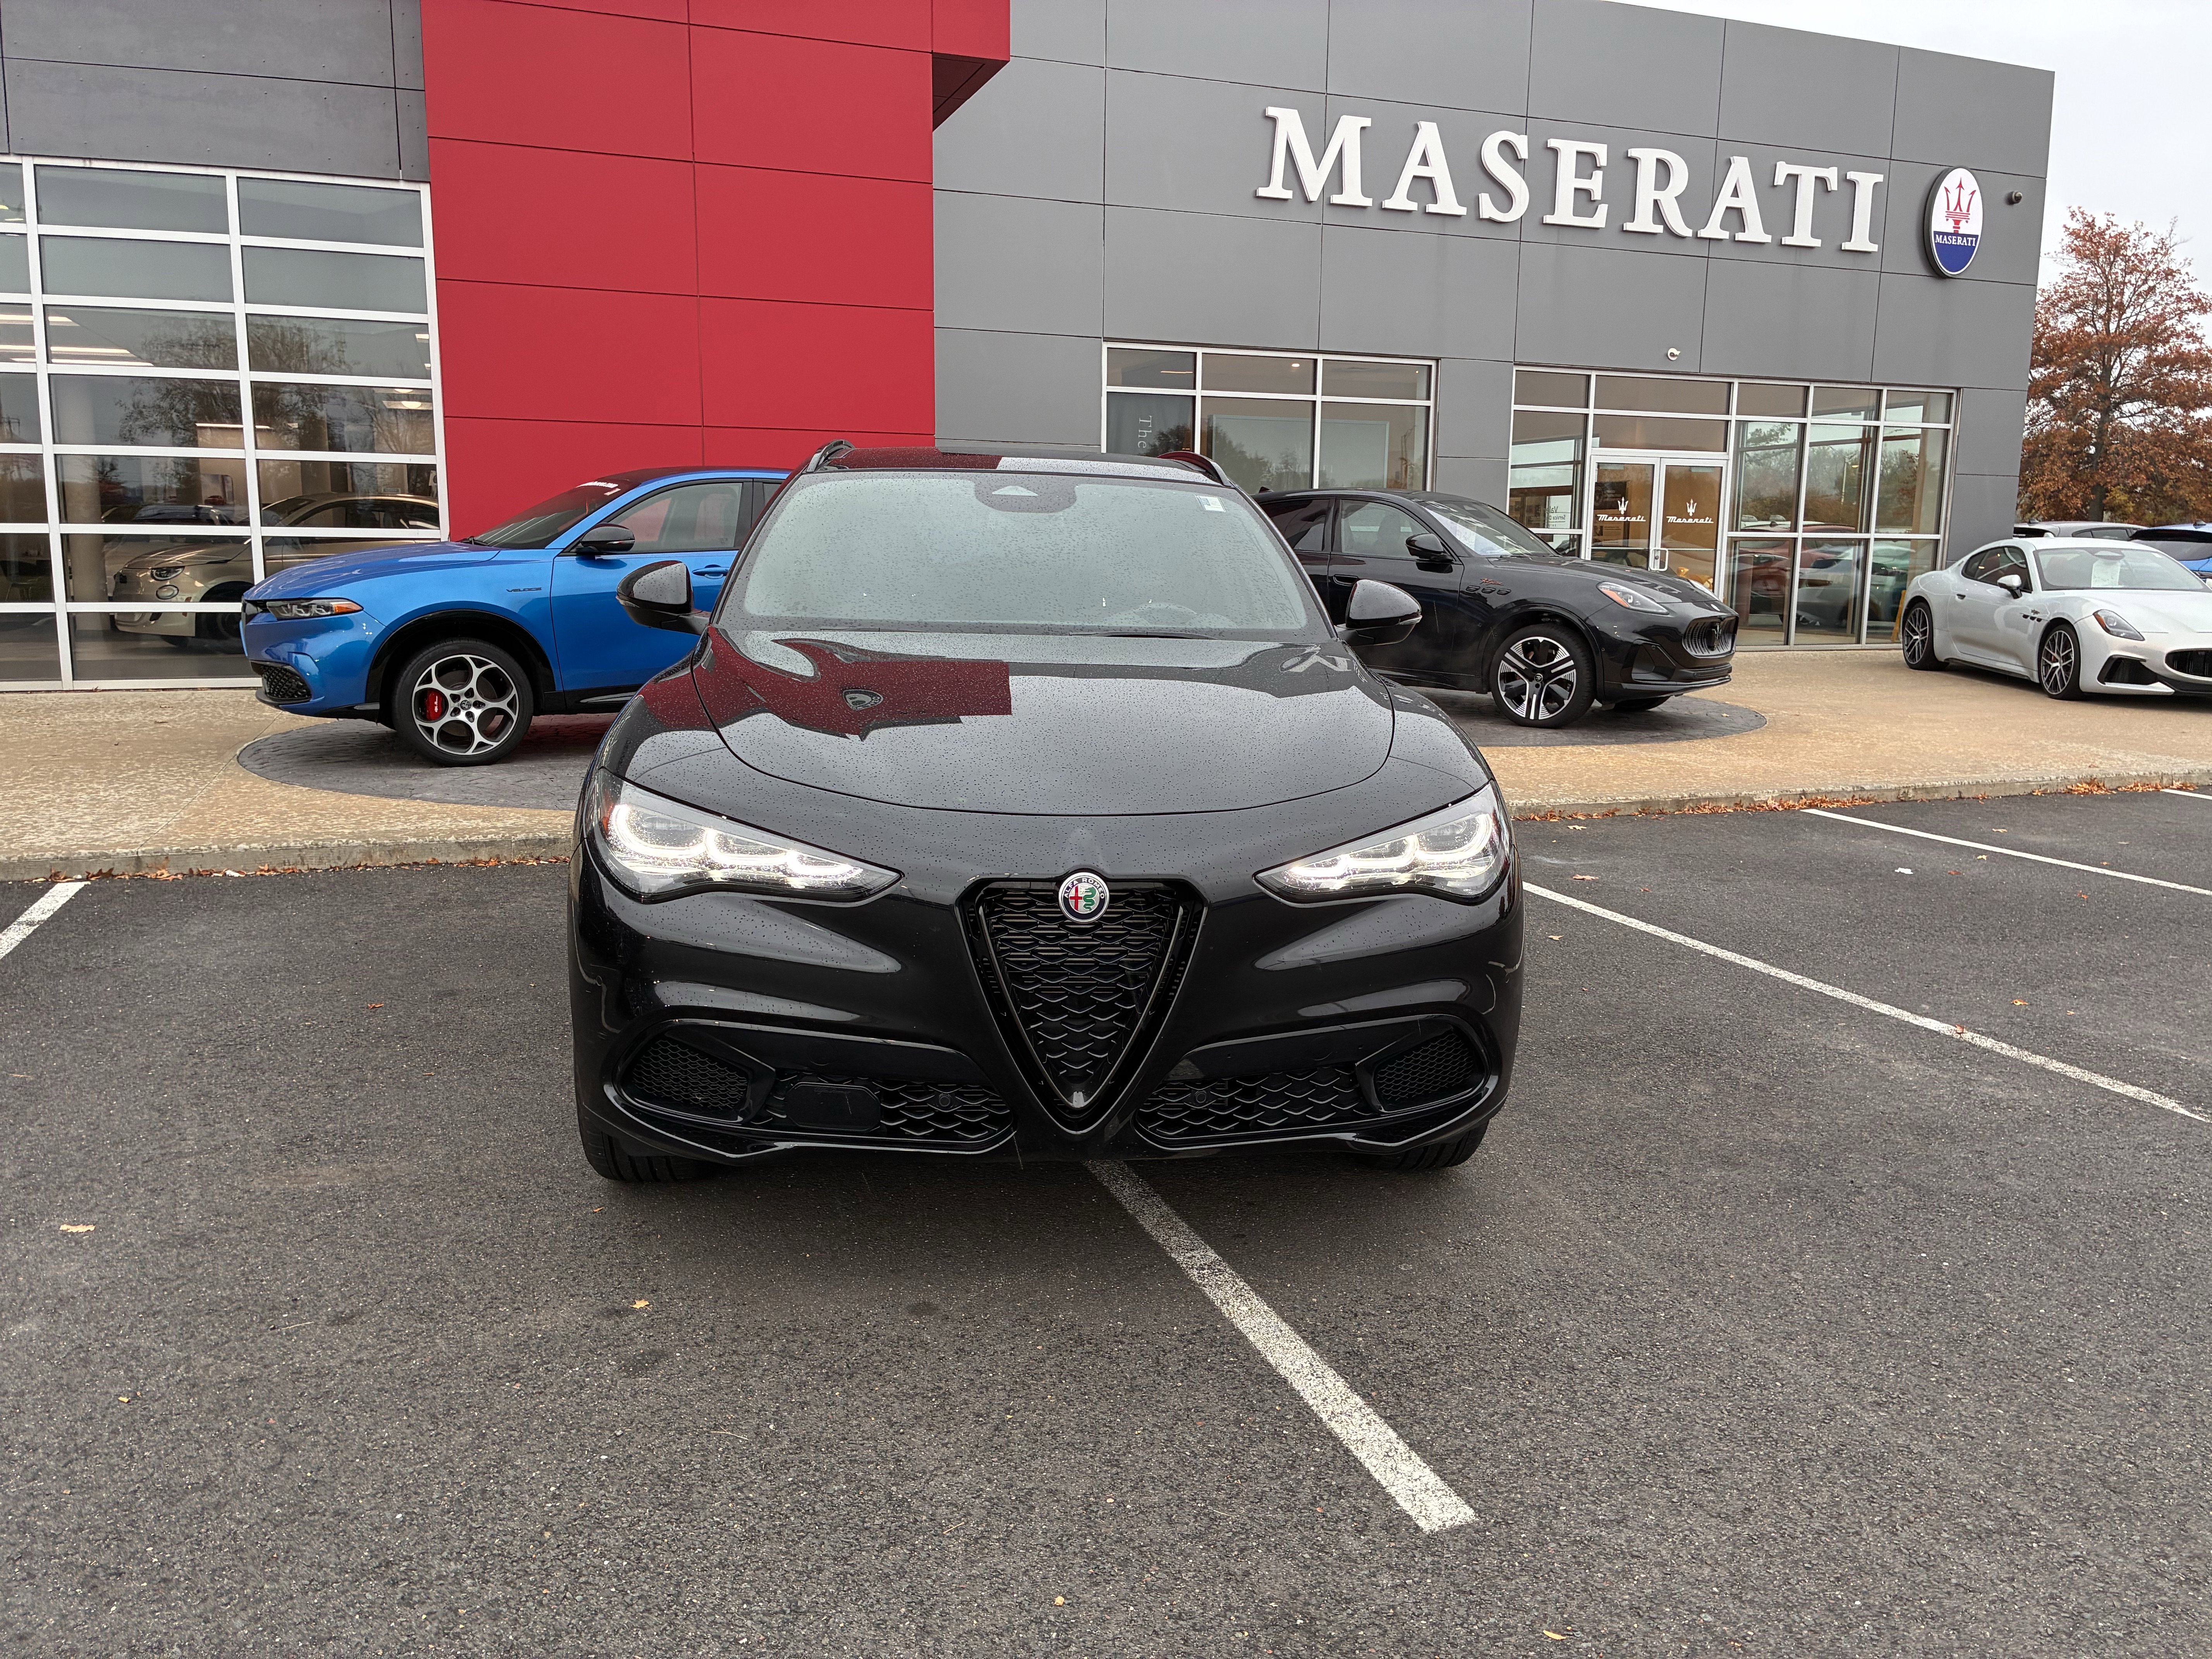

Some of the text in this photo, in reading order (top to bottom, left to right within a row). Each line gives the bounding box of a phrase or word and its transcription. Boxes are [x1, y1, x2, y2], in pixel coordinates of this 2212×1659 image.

[1256, 106, 1884, 252] MASERATI
[1935, 234, 1976, 246] MASERATI
[1138, 416, 1152, 448] The
[1666, 515, 1714, 524] Maserati
[1064, 878, 1104, 898] ALFA ROMEO
